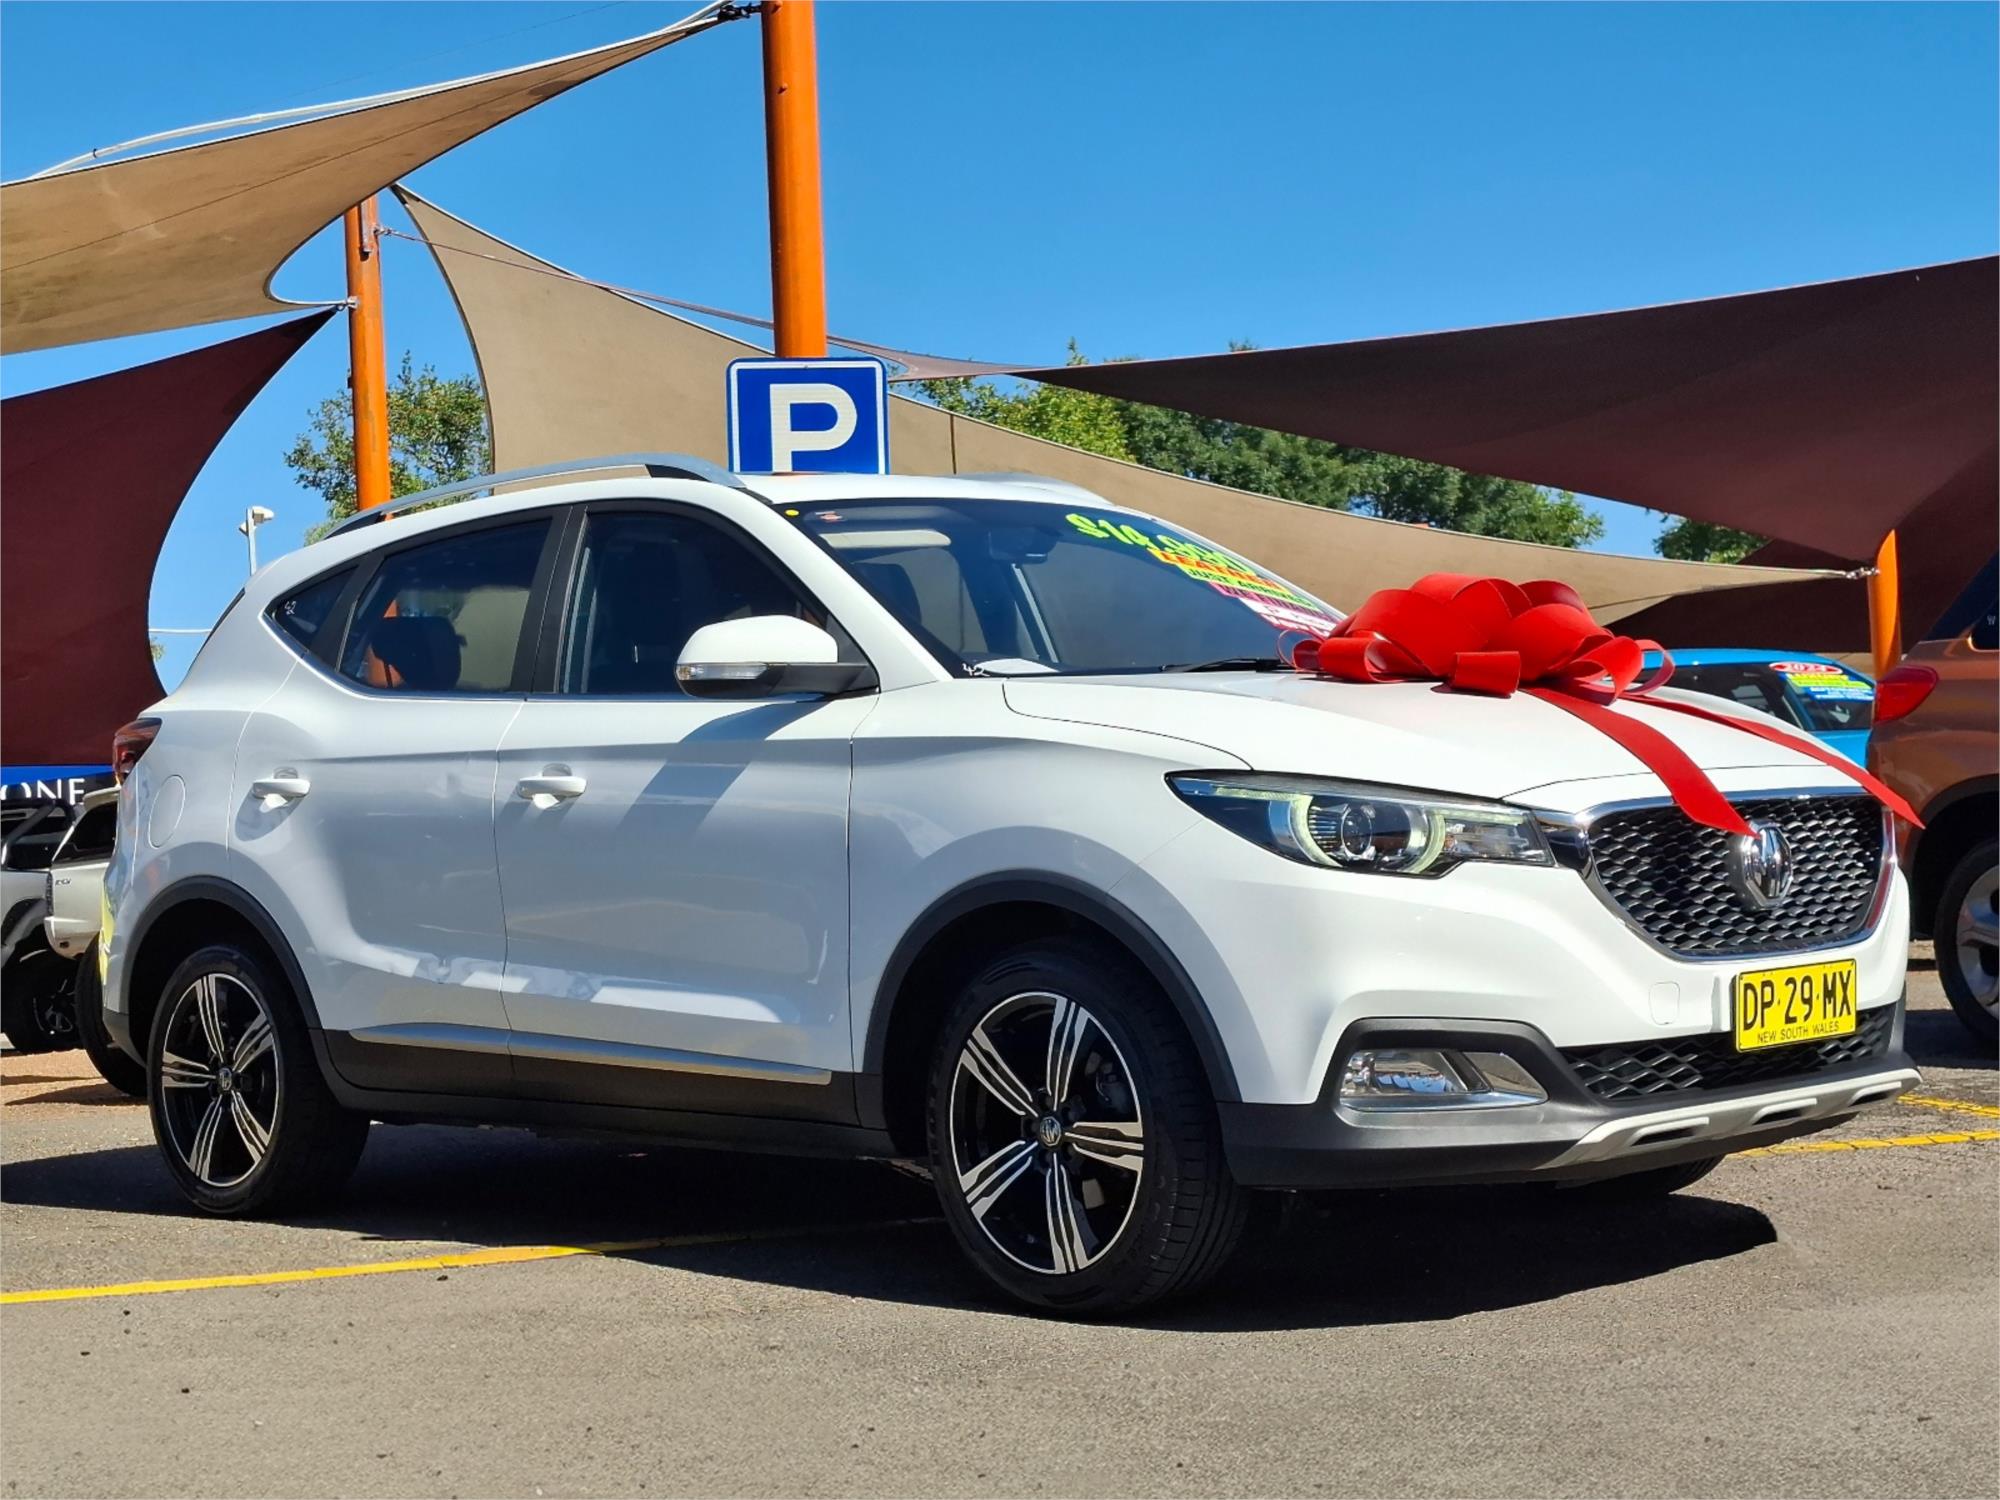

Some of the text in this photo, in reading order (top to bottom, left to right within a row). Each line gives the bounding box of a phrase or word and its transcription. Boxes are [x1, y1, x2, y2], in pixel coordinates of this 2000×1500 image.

[769, 383, 858, 473] P
[1757, 1020, 1840, 1043] NEW SOUTH WALES
